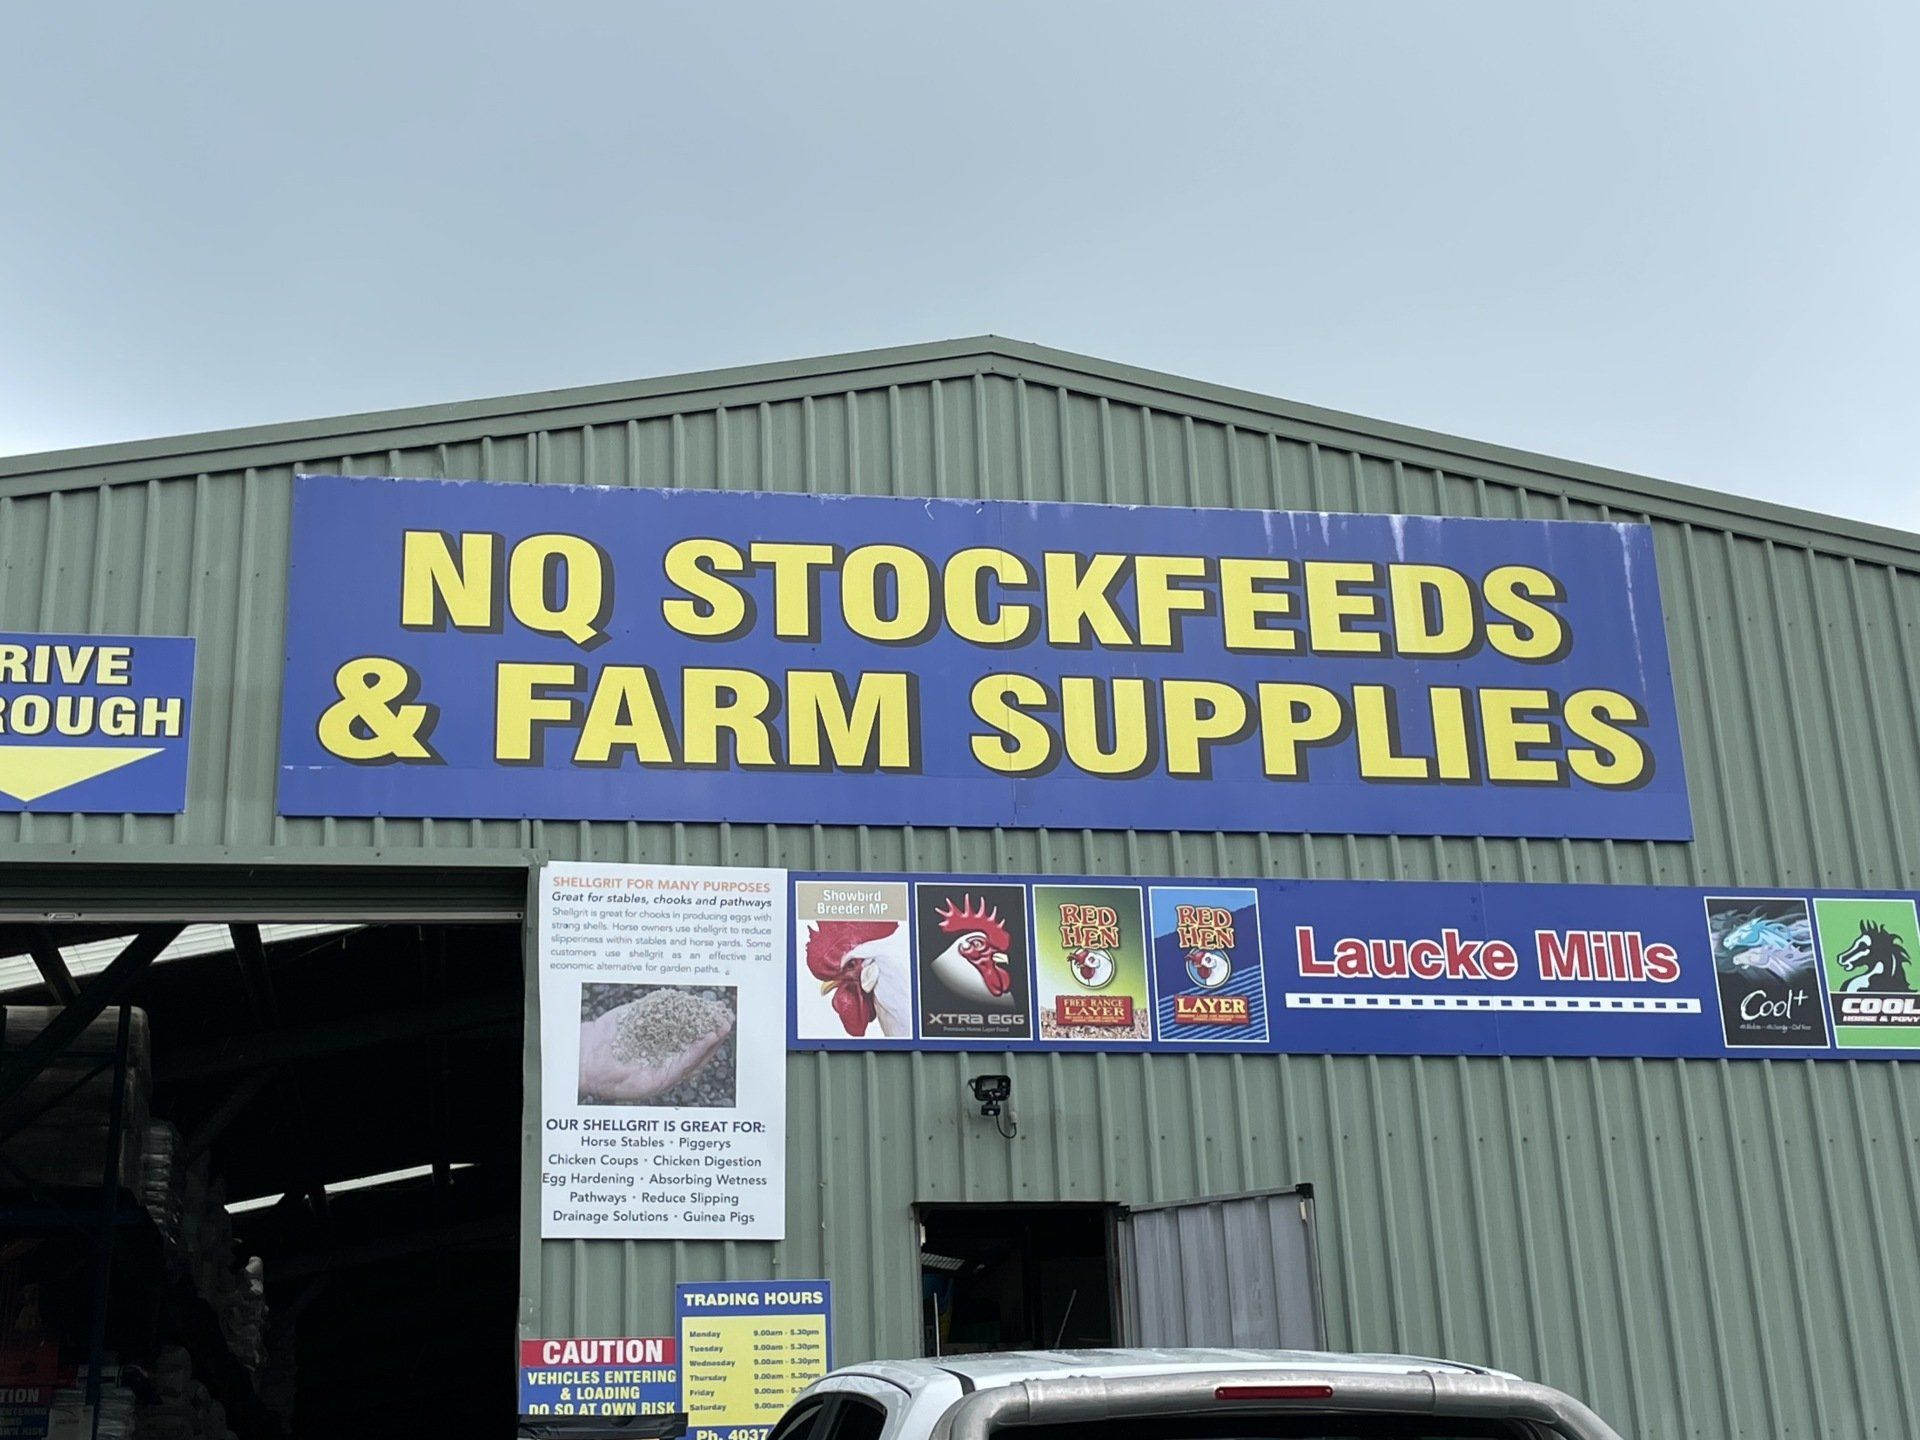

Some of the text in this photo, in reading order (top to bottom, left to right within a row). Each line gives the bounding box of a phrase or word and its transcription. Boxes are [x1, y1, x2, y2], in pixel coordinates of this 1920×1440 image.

[402, 530, 1562, 660] NQ STOCKFEEDS
[0, 695, 182, 737] OUGH
[317, 657, 1644, 785] & FARM SUPPLIES
[553, 877, 770, 893] SHELLGRIT FOR MANY PURPOSES
[552, 892, 772, 909] Great for stables, chooks and pathways
[823, 890, 881, 901] Showbird
[553, 908, 588, 918] Shellgrit
[591, 909, 597, 917] is
[600, 910, 622, 919] great
[683, 912, 727, 922] producing
[730, 915, 751, 923] eggs
[754, 914, 771, 922] with
[817, 902, 888, 914] Breeder MP
[1060, 904, 1117, 927] RED
[1176, 905, 1232, 928] RED
[552, 922, 580, 931] strong
[583, 922, 608, 931] shells.
[613, 923, 638, 931] Horse
[693, 925, 727, 936] shellgrit
[742, 927, 771, 935] reduce
[551, 935, 771, 949] slipperiness within stables and horse yards. Some
[1060, 926, 1119, 949] HEN
[1178, 927, 1235, 949] HEN
[551, 949, 596, 957] customers
[629, 950, 663, 960] shellgrit
[709, 952, 746, 961] effective
[755, 953, 771, 961] and
[1295, 926, 1680, 983] Laucke Mills
[550, 962, 719, 975] economic alternative for garden paths.
[1065, 1007, 1124, 1015] LAYER
[1177, 998, 1245, 1013] LAYER
[1842, 998, 1920, 1014] COOL
[546, 1119, 765, 1133] OUR SHELLGRIT IS GREAT FOR:
[581, 1137, 730, 1150] Horse Stables Piggerys
[549, 1155, 761, 1169] Chicken Coups Chicken Digestion
[543, 1173, 767, 1187] Egg Hardening Absorbing Wetness
[570, 1192, 738, 1206] Pathways Reduce Slipping
[553, 1211, 755, 1225] Drainage Solutions Guinea Pigs
[684, 1291, 823, 1306] TRADING HOURS
[543, 1340, 663, 1364] CAUTION
[528, 1370, 677, 1385] VEHICLES ENTERING
[561, 1386, 640, 1400] & LOADING
[529, 1402, 675, 1415] DO SO AT OWN RISK
